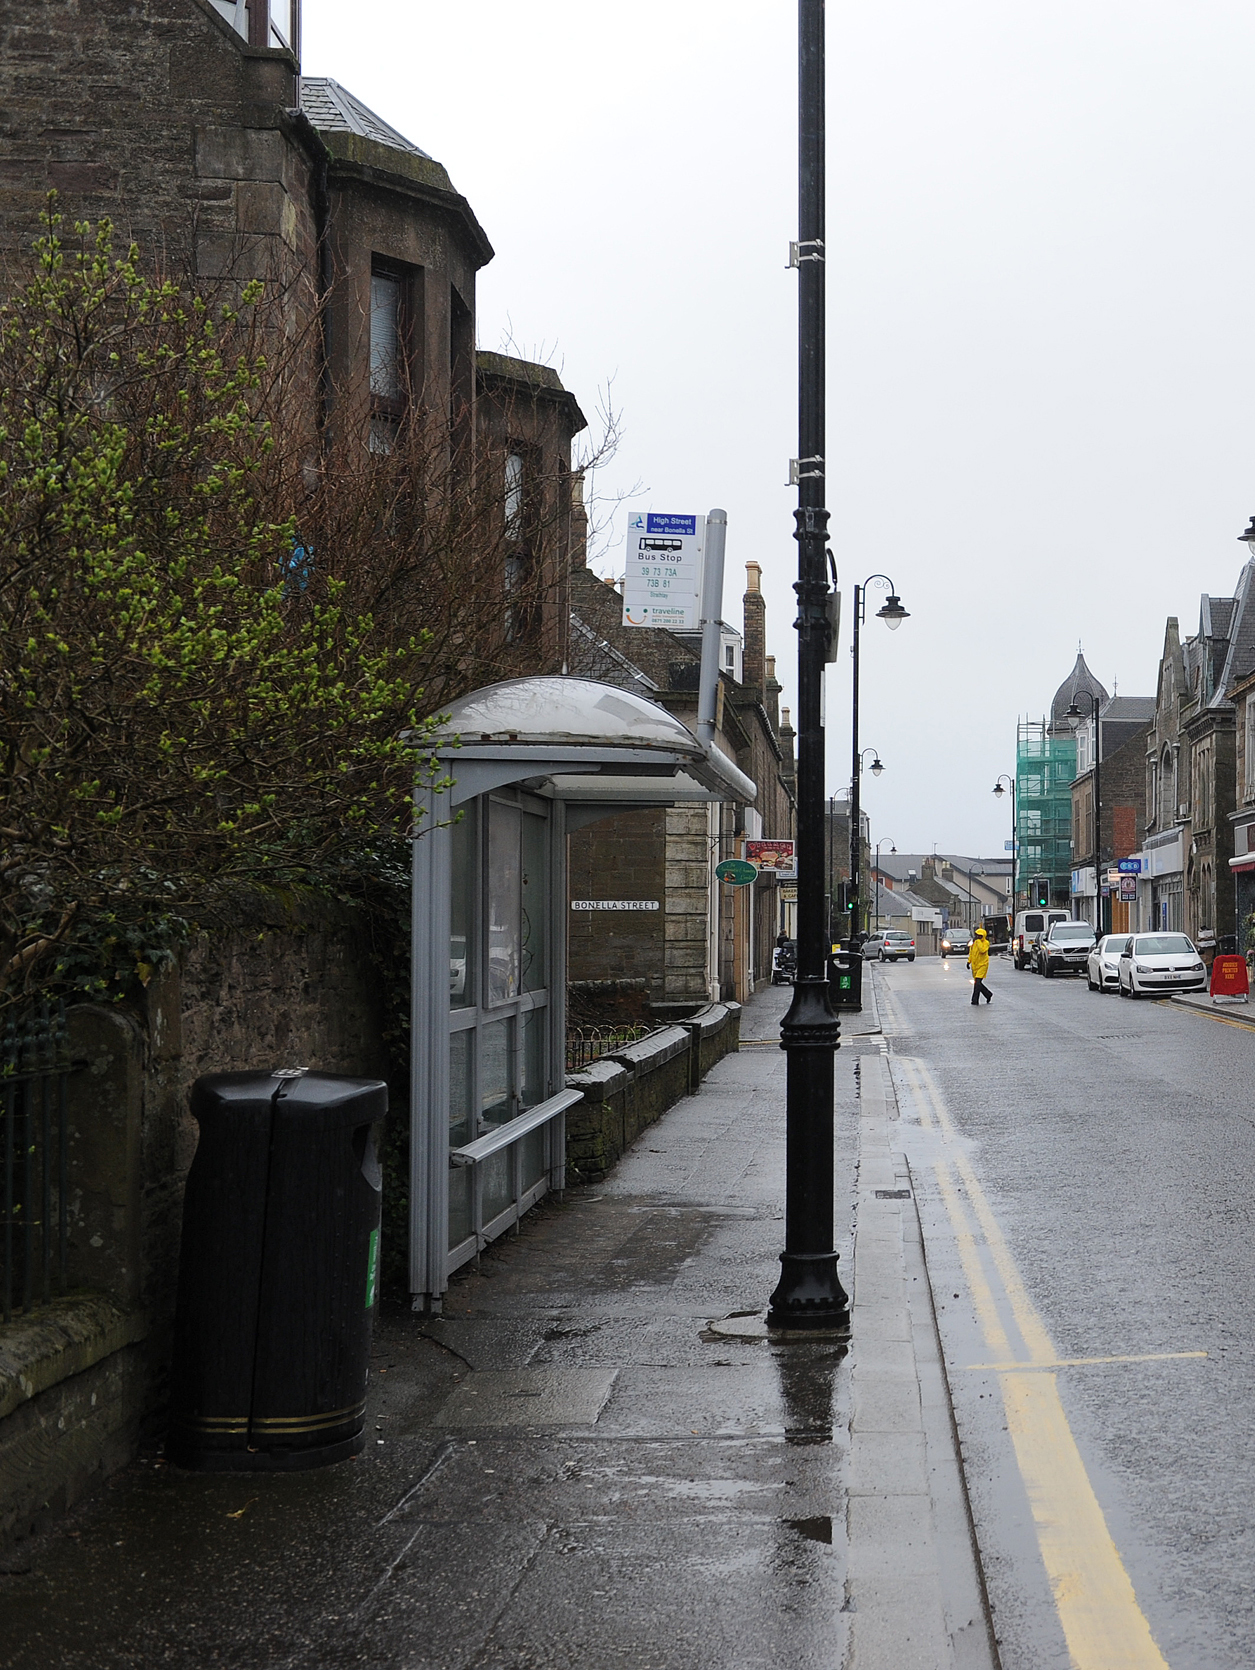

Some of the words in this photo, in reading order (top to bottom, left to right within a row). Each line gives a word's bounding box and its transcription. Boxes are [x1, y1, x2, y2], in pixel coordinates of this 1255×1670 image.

[653, 517, 669, 525] High
[638, 552, 656, 560] Bus
[660, 553, 682, 563] Stop
[641, 567, 649, 575] 39
[653, 567, 661, 576] 73
[664, 568, 677, 576] 73A
[647, 579, 659, 587] 73B
[662, 579, 670, 588] 81
